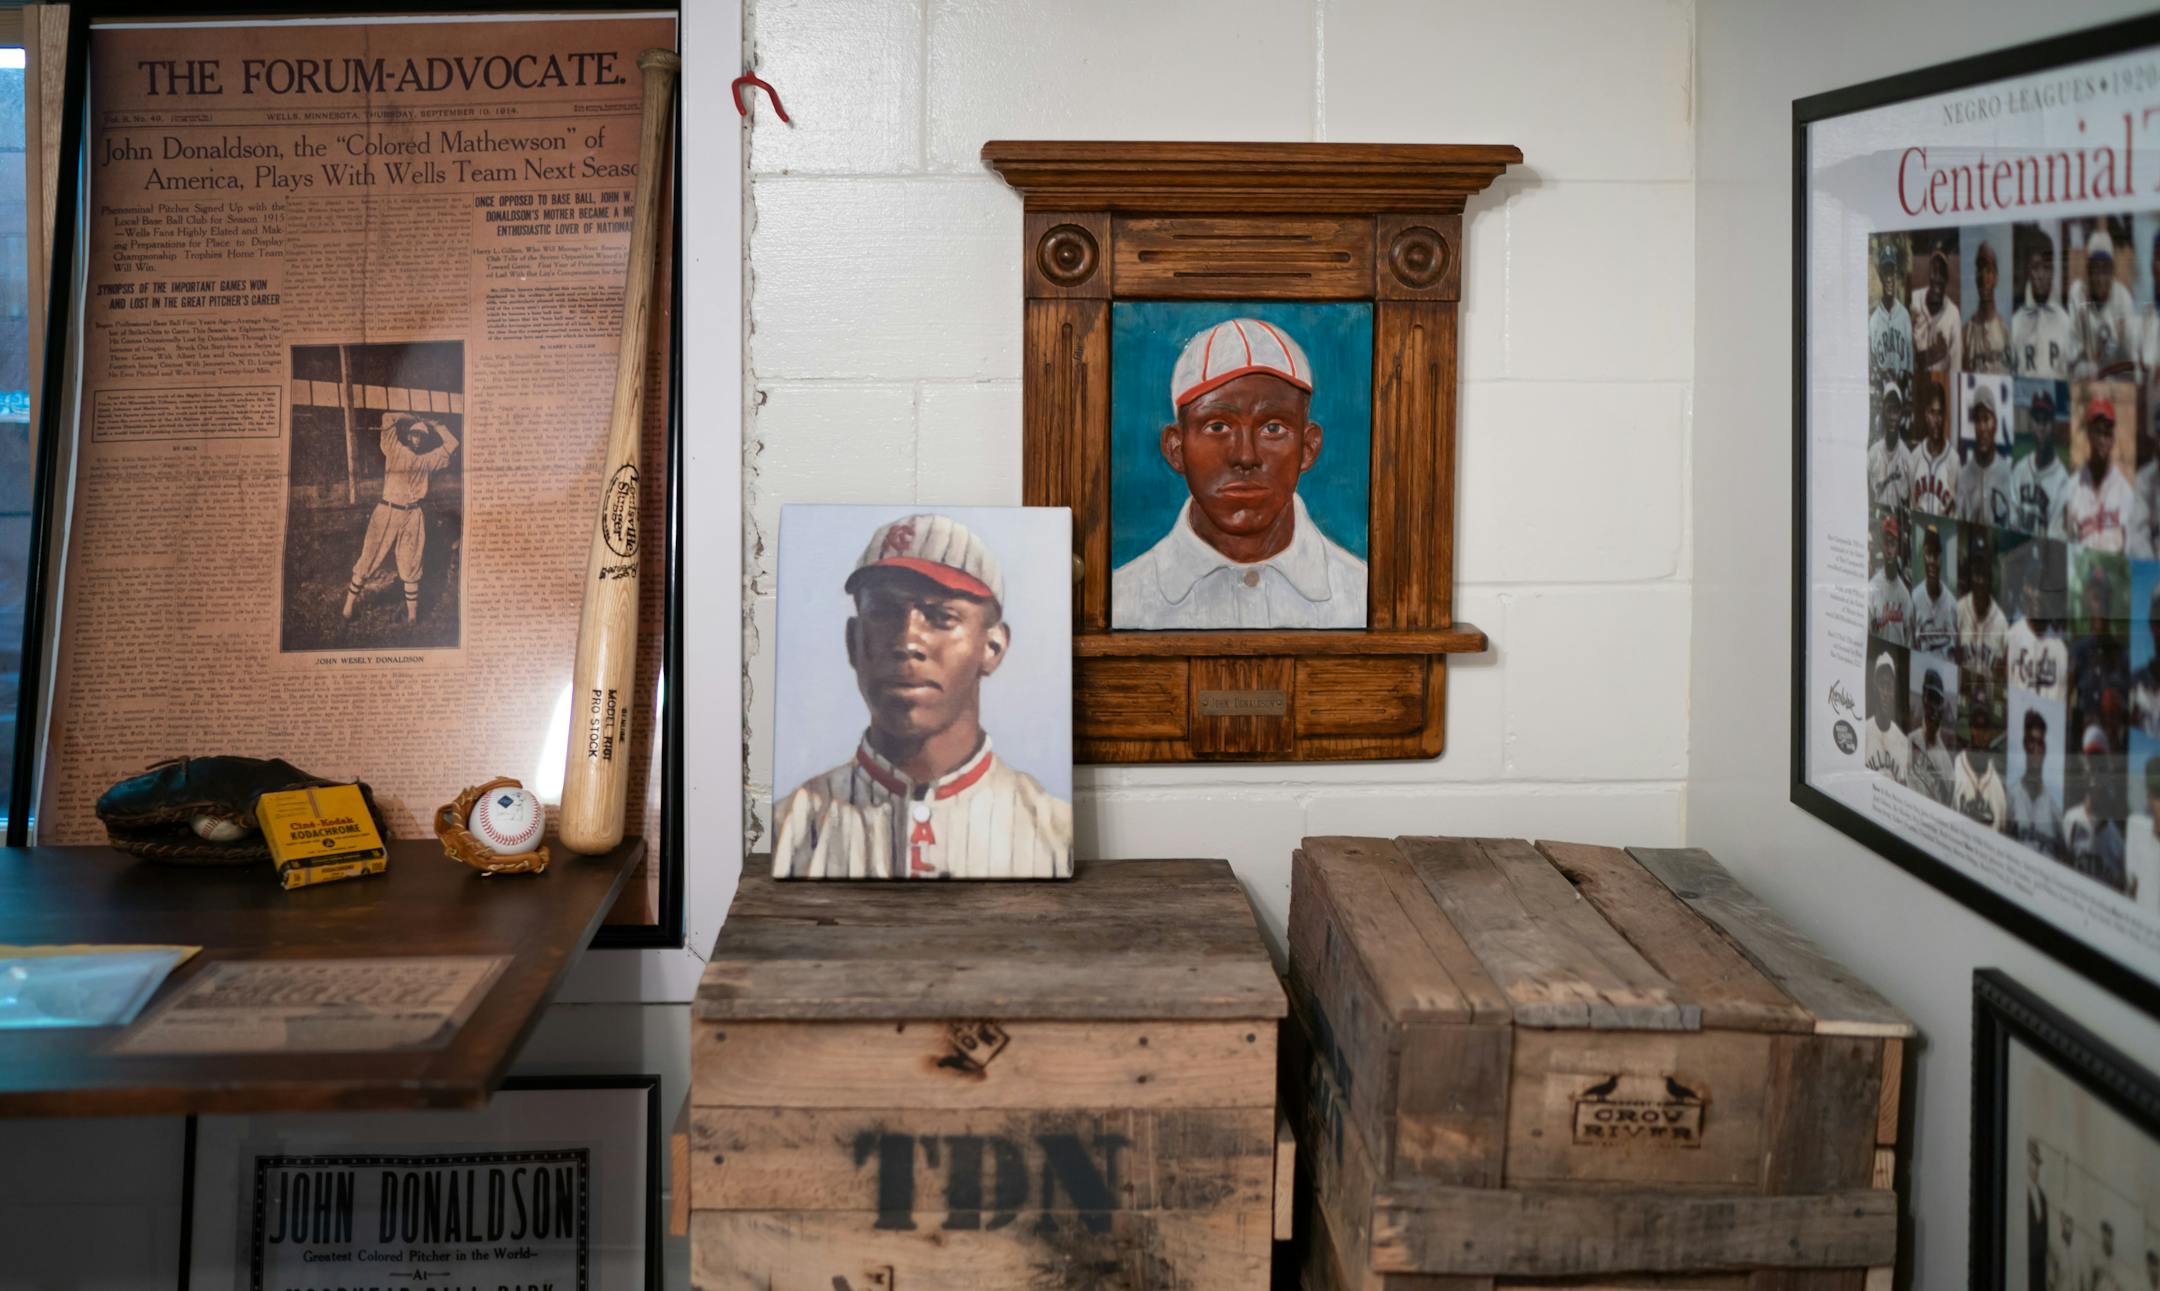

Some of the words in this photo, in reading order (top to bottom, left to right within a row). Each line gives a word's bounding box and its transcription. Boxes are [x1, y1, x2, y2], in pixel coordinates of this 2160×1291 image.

[138, 60, 222, 96] THE
[242, 52, 625, 94] FORUM-ADVOCATE.
[1943, 96, 2002, 127] NEGRO
[2008, 77, 2095, 114] LEAGUES
[420, 108, 474, 117] SEPTEMBER
[102, 137, 151, 166] John
[163, 133, 283, 161] Donaldson,
[294, 134, 326, 157] the
[441, 127, 575, 153] Mathewson”
[584, 125, 605, 148] of
[1897, 112, 2137, 217] Centennial
[143, 165, 243, 191] America,
[255, 164, 313, 192] Plays
[321, 162, 374, 186] With
[384, 160, 445, 184] Wells
[452, 159, 516, 182] Team
[524, 158, 574, 180] Next
[582, 156, 639, 179] Seaso
[475, 196, 494, 207] ONCE
[499, 195, 533, 206] OPPOSED
[537, 195, 547, 205] TO
[551, 194, 570, 204] BASE
[600, 193, 618, 202] JOHN
[623, 192, 633, 201] W.
[194, 203, 223, 214] Signed
[229, 203, 243, 213] Up
[247, 202, 266, 211] with
[271, 202, 284, 211] the
[543, 209, 574, 220] MOTHER
[579, 208, 608, 218] BECAME
[614, 207, 618, 217] A
[623, 207, 634, 218] MO
[114, 217, 138, 226] Local
[142, 217, 162, 225] Base
[166, 216, 182, 224] Ball
[186, 216, 207, 224] Club
[210, 216, 222, 224] for
[225, 215, 257, 223] Season
[264, 214, 284, 222] 1915
[153, 228, 174, 236] Fans
[177, 227, 207, 237] Highly
[210, 227, 238, 236] Elated
[241, 226, 258, 237] and
[497, 224, 550, 236] ENTHUSIASTIC
[555, 224, 578, 234] LOVER
[583, 223, 592, 233] OF
[596, 222, 632, 234] NATIONA
[130, 239, 185, 250] Preparations
[188, 239, 201, 247] for
[206, 238, 230, 249] Place
[234, 239, 245, 248] to
[251, 237, 283, 248] Display
[113, 252, 176, 262] Championship
[184, 251, 222, 260] Trophies
[227, 250, 254, 258] Home
[113, 264, 131, 272] Will
[97, 284, 134, 296] SYNOPSIS
[139, 283, 149, 293] OF
[152, 283, 166, 293] THE
[171, 282, 215, 292] IMPORTANT
[220, 281, 246, 291] GAMES
[250, 280, 266, 290] WON
[109, 299, 125, 309] AND
[130, 299, 148, 309] LOST
[152, 298, 159, 308] IN
[164, 298, 177, 308] THE
[181, 297, 205, 307] GREAT
[251, 295, 279, 305] CAREER
[612, 481, 629, 542] Slugger
[591, 689, 602, 713] PRO
[605, 688, 617, 729] MODEL
[588, 718, 600, 758] STOCK
[290, 824, 361, 840] KODACHROME
[911, 820, 937, 878] AL
[1583, 1125, 1692, 1140] RIVER
[269, 1172, 354, 1244] JOHN
[379, 1166, 574, 1243] DONALDSON
[303, 1249, 352, 1263] Greatest
[358, 1248, 403, 1262] Colored
[409, 1249, 451, 1262] Pitcher
[456, 1249, 467, 1261] in
[472, 1249, 490, 1261] the
